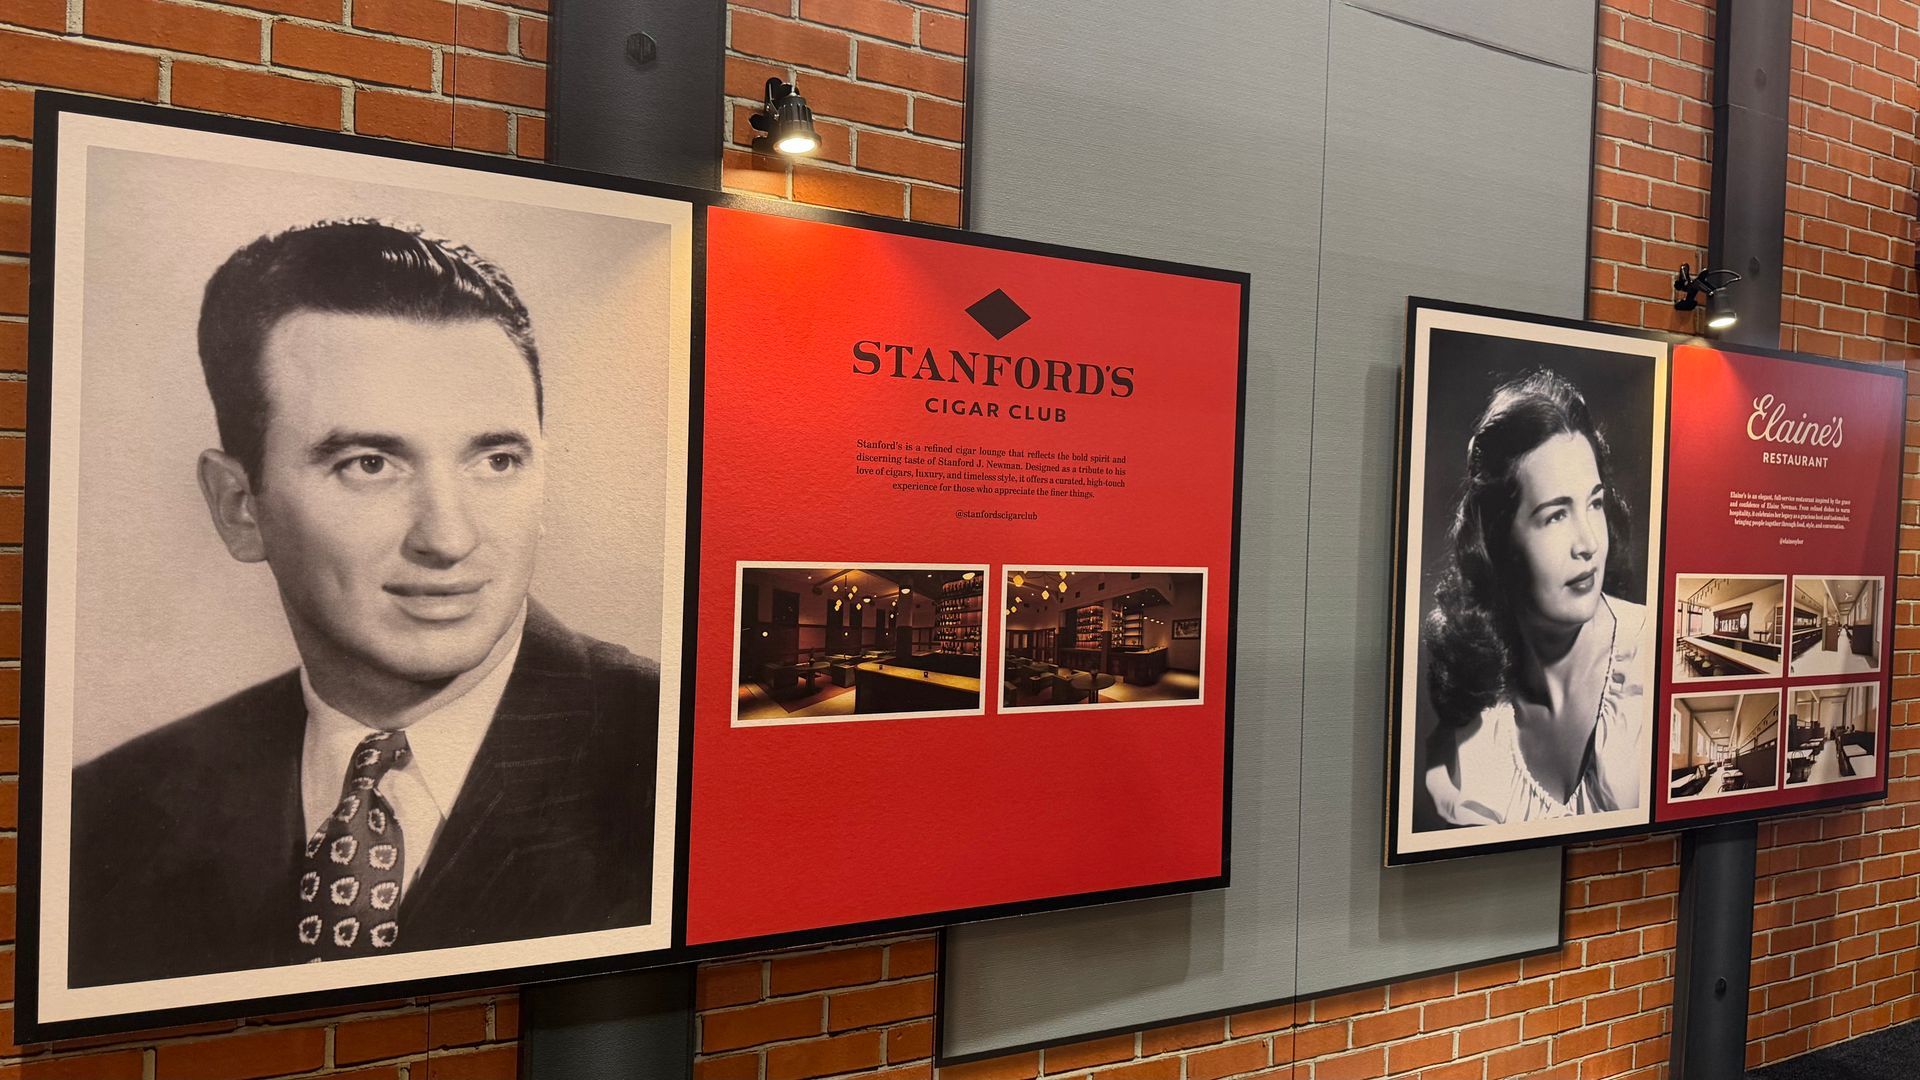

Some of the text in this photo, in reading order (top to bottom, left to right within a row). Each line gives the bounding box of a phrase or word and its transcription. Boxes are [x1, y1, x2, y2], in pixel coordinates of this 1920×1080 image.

[853, 340, 1134, 398] STANFORD'S
[925, 397, 1066, 422] CIGAR CLUB
[1746, 394, 1843, 448] Elaine's
[856, 439, 902, 450] Stanford's
[906, 442, 912, 451] is
[924, 444, 952, 453] refined
[956, 446, 976, 455] cigar
[980, 447, 1006, 458] lounge
[1009, 449, 1024, 457] that
[1027, 451, 1055, 460] reflects
[1058, 452, 1069, 460] the
[1072, 452, 1088, 461] bold
[1090, 454, 1109, 463] spirit
[1762, 452, 1828, 468] RESTAURANT
[857, 453, 901, 464] discerning
[938, 457, 974, 467] Stanford
[987, 461, 1022, 470] Newman.
[1026, 463, 1059, 473] Designed
[1079, 466, 1104, 474] tribute
[1115, 467, 1126, 475] his
[856, 466, 873, 474] love
[885, 468, 914, 478] cigars,
[915, 469, 944, 480] luxury,
[964, 472, 996, 481] timeless
[998, 474, 1017, 483] style,
[1026, 475, 1048, 484] offers
[1055, 478, 1085, 486] curated,
[1086, 478, 1125, 487] high-touch
[892, 482, 1094, 499] experience for those who appreciate the finer things.
[956, 509, 1037, 520] @stanfordscigarclub
